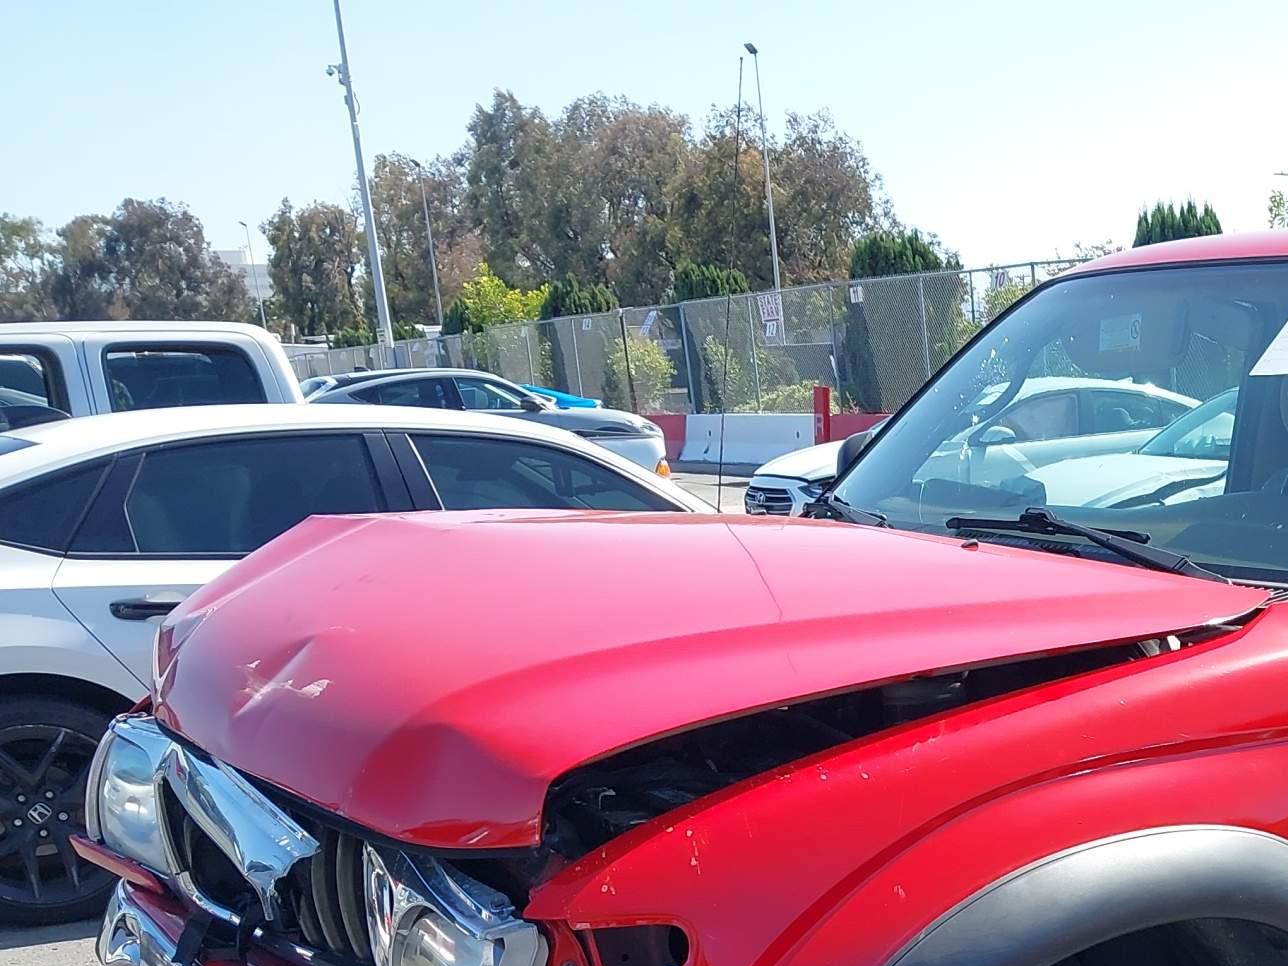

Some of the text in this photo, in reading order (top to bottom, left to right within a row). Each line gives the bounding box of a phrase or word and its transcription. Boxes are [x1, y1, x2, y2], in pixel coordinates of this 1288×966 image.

[994, 271, 1005, 287] 10
[759, 294, 779, 307] STATE
[852, 286, 860, 302] 11
[767, 323, 776, 336] 12
